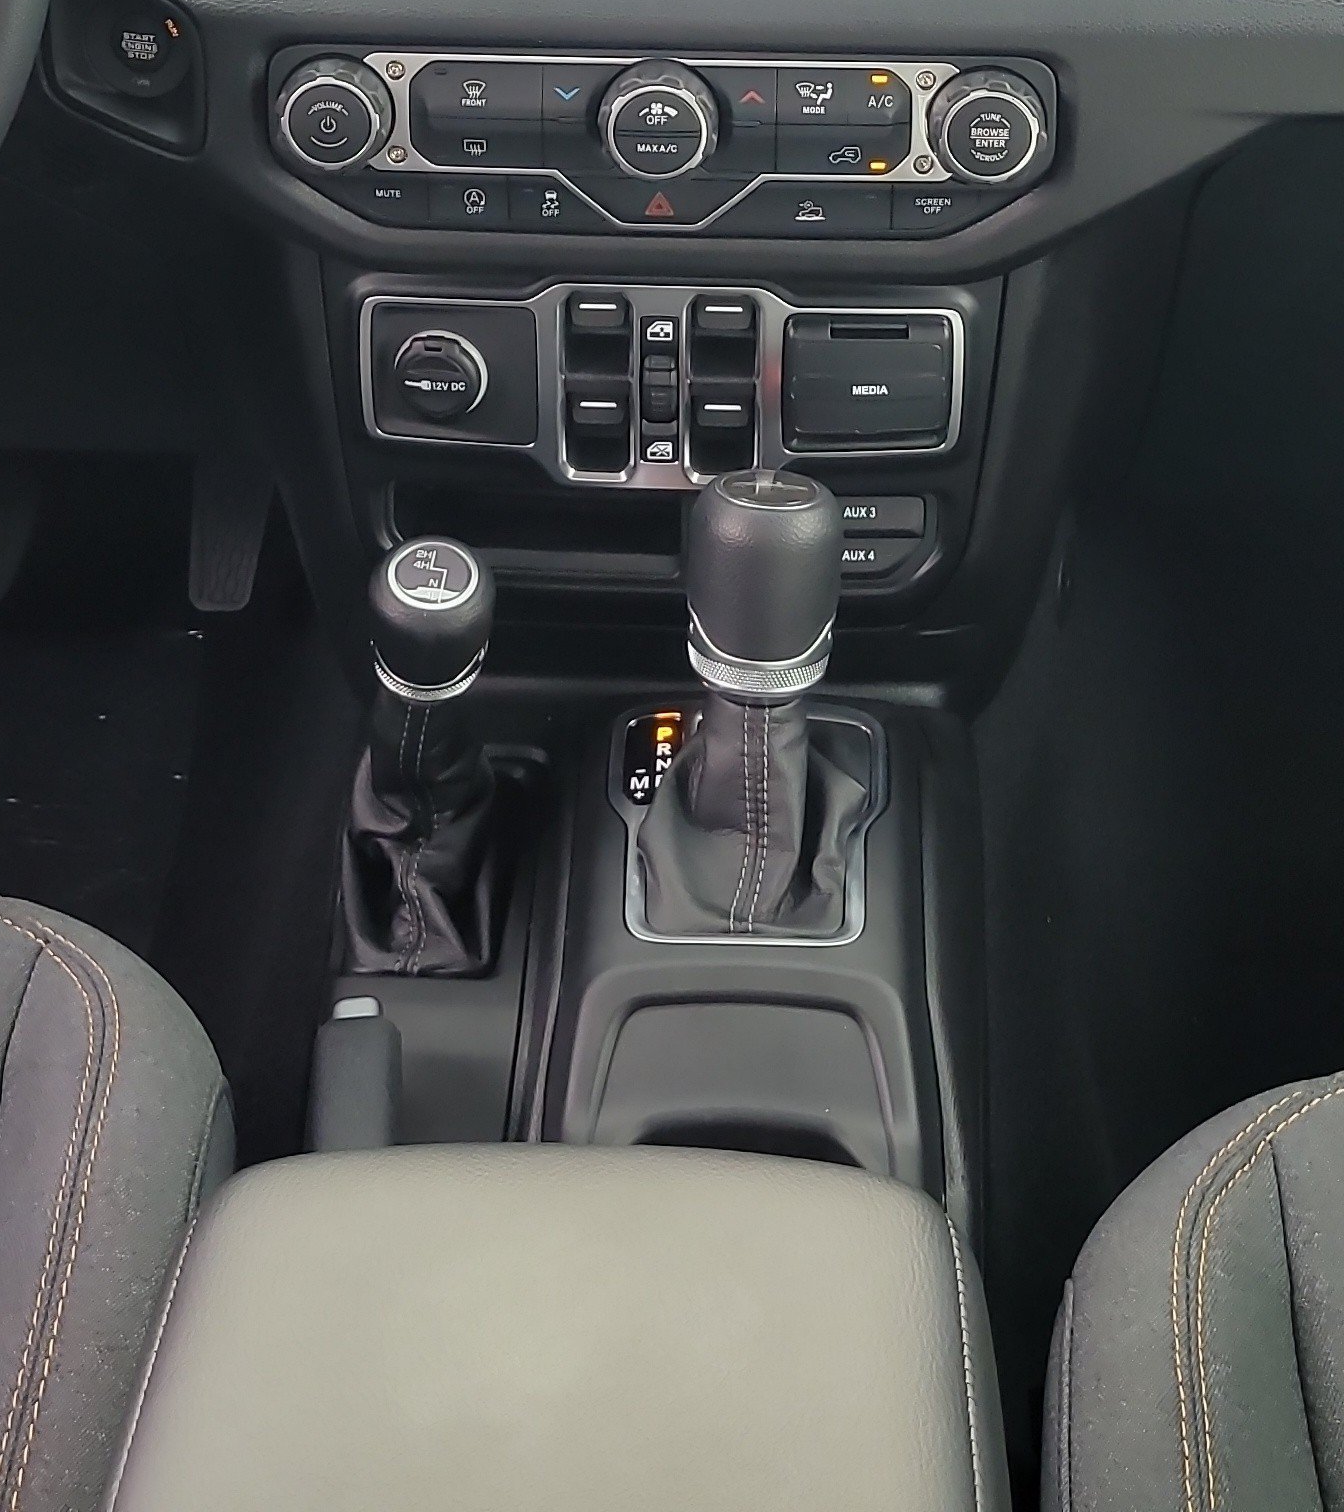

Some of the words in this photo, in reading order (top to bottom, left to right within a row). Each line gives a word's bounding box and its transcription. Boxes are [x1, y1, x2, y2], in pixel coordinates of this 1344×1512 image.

[123, 32, 156, 42] START
[123, 42, 158, 53] ENGINE
[127, 52, 155, 60] STOP
[461, 98, 487, 107] FRONT
[868, 94, 894, 108] A/C
[312, 101, 344, 113] VOLUME
[802, 105, 826, 115] MODE
[646, 115, 669, 126] OFF
[981, 113, 1002, 123] TUNE
[971, 127, 1010, 138] BROWSE
[637, 143, 659, 153] MAX
[659, 143, 678, 154] A/C
[975, 139, 1006, 149] ENTER
[975, 152, 1006, 162] SCROLL
[376, 189, 402, 199] MUTE
[915, 197, 952, 206] SCREEN
[466, 206, 484, 215] OFF
[542, 208, 560, 218] OFF
[923, 206, 942, 215] OFF
[430, 380, 449, 392] 12V
[451, 380, 466, 392] DC
[851, 384, 889, 396] MEDIA
[843, 506, 865, 519] AUX
[867, 506, 877, 519] 3
[416, 549, 432, 559] 2H
[841, 549, 864, 562] AUX
[866, 549, 875, 562] 4
[414, 560, 430, 569] 4H
[428, 578, 438, 588] N
[657, 726, 673, 740] P
[657, 743, 672, 756] R
[656, 757, 672, 772] N
[630, 776, 650, 791] M
